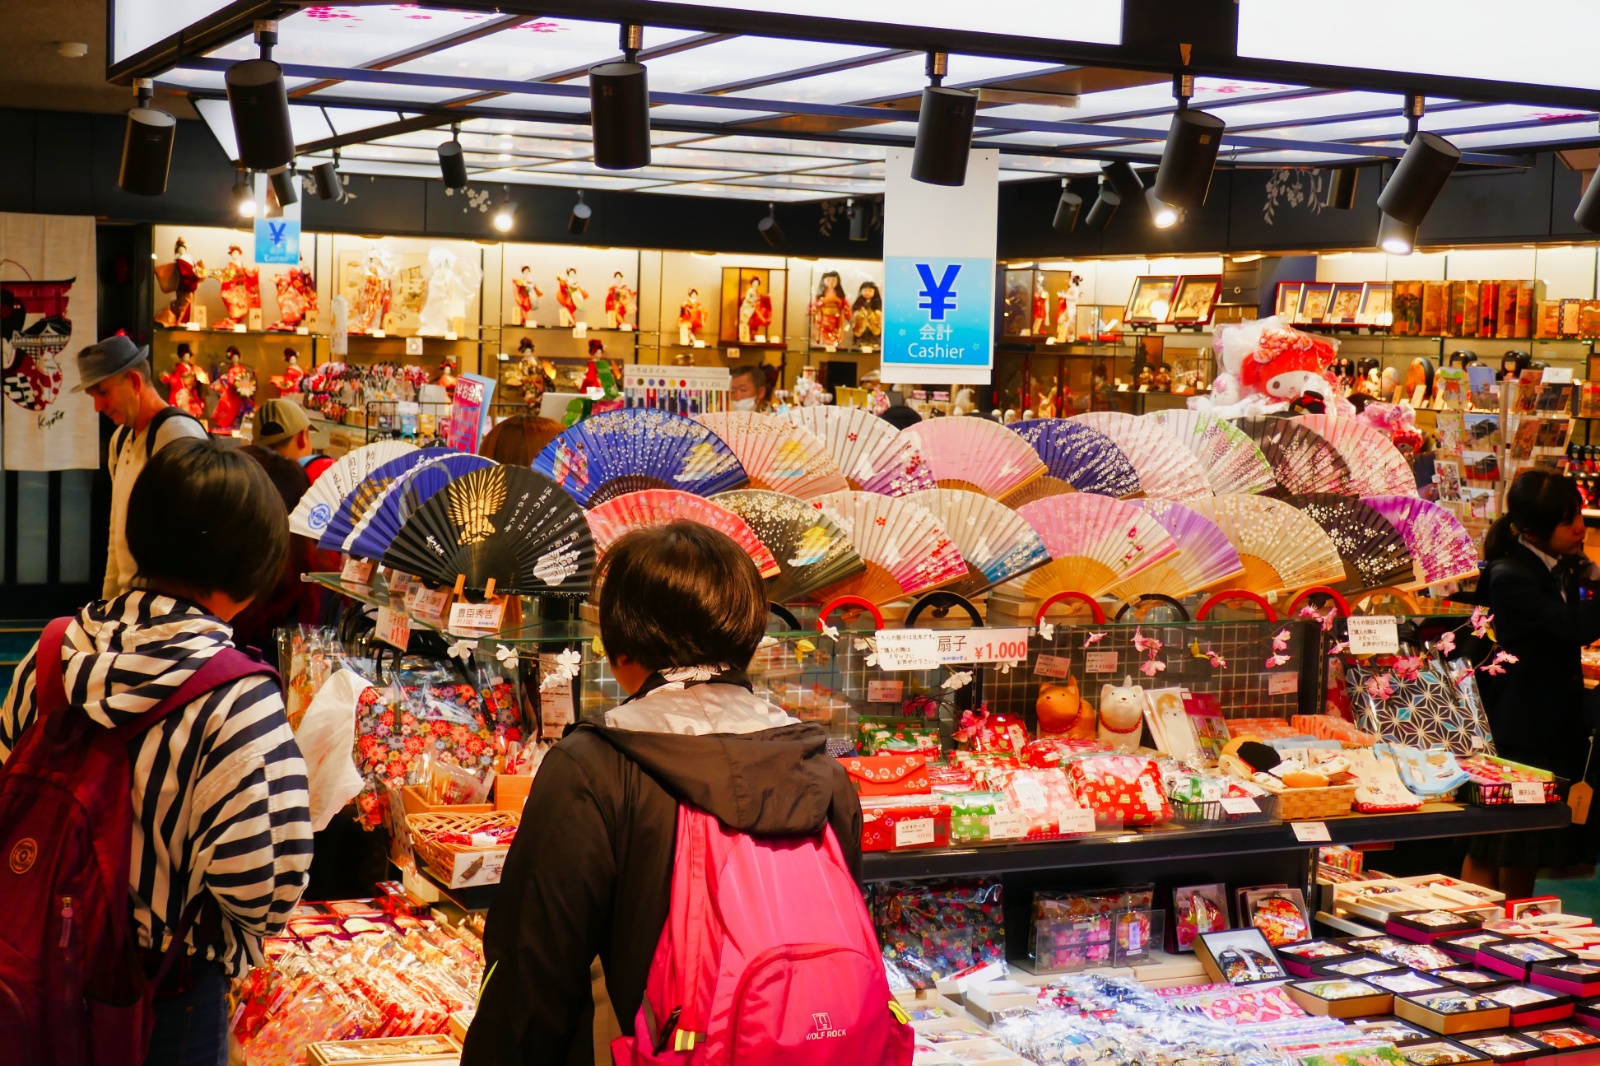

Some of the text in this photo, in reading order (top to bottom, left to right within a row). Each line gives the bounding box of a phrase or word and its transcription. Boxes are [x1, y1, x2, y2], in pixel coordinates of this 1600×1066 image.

[919, 323, 954, 342] 会計
[907, 342, 965, 359] Cashier
[37, 410, 65, 430] Kyoto
[457, 608, 494, 619] 豊臣秀吉
[937, 635, 968, 652] 扇子
[806, 1029, 846, 1040] WOLF ROCK
